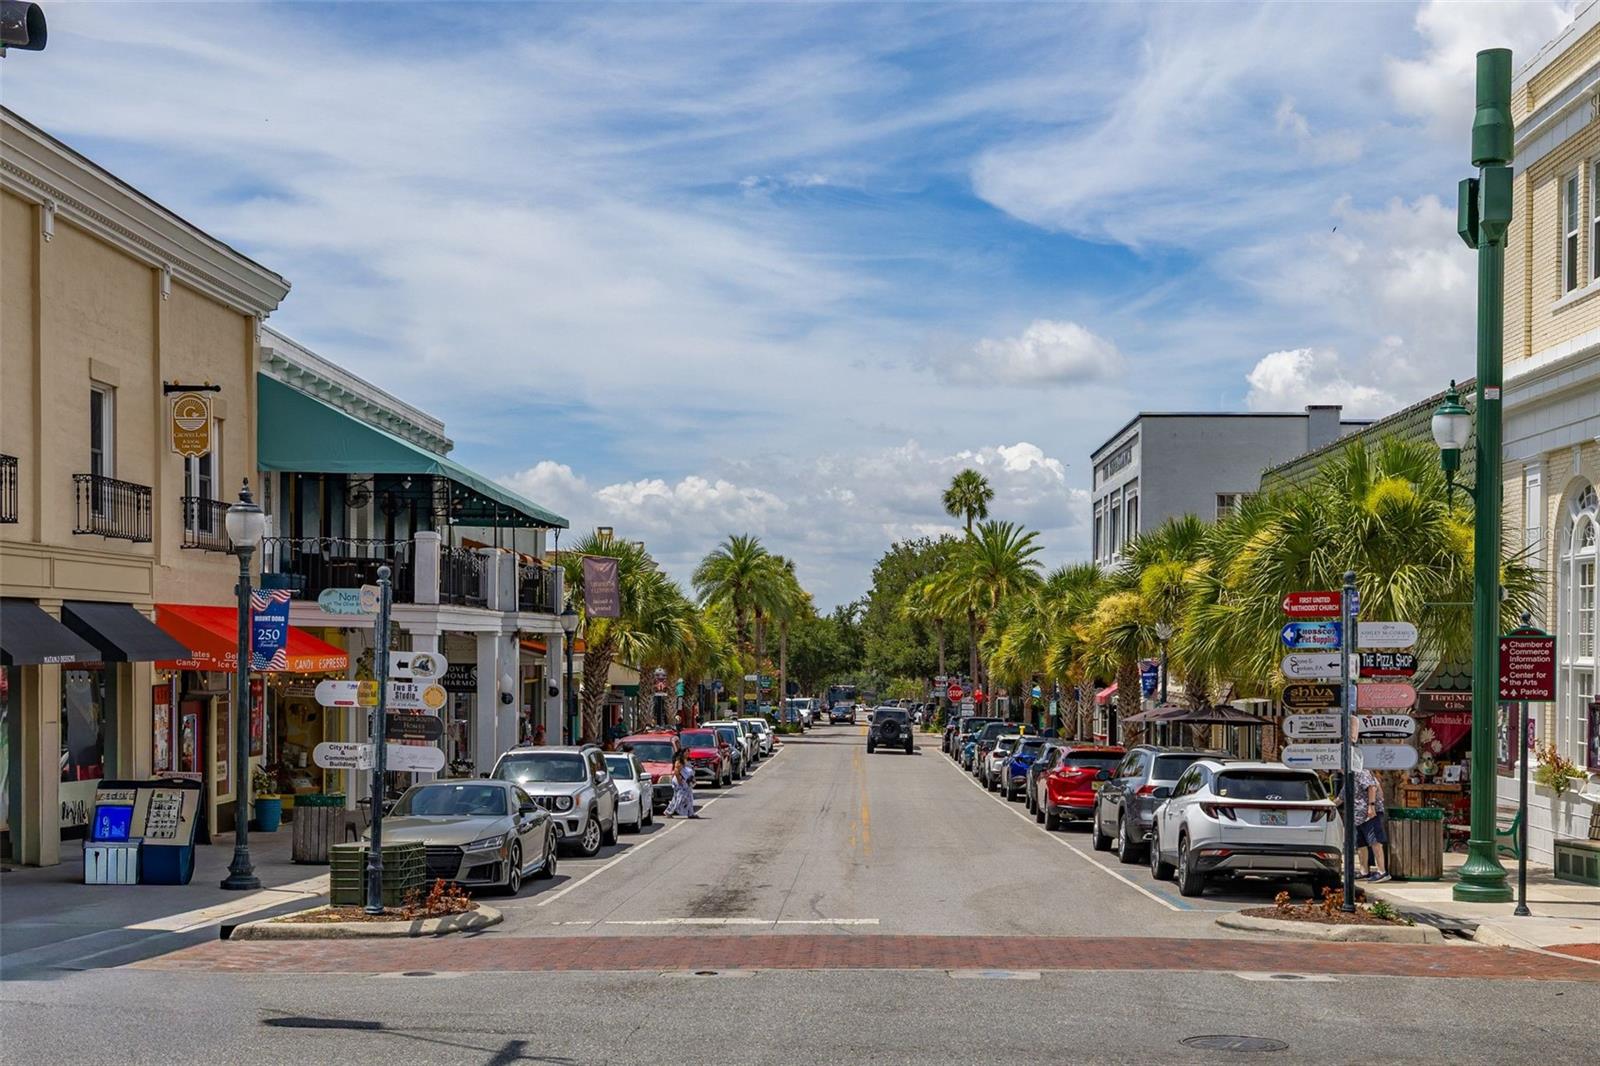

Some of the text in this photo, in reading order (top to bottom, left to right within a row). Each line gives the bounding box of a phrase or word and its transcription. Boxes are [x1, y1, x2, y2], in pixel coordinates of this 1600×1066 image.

[258, 629, 280, 640] 250
[176, 660, 200, 668] Candy
[319, 657, 347, 669] ESPRESSO
[1362, 653, 1413, 667] THE PIZZA SHOP
[395, 692, 416, 700] Studio
[1431, 714, 1462, 724] Handmade
